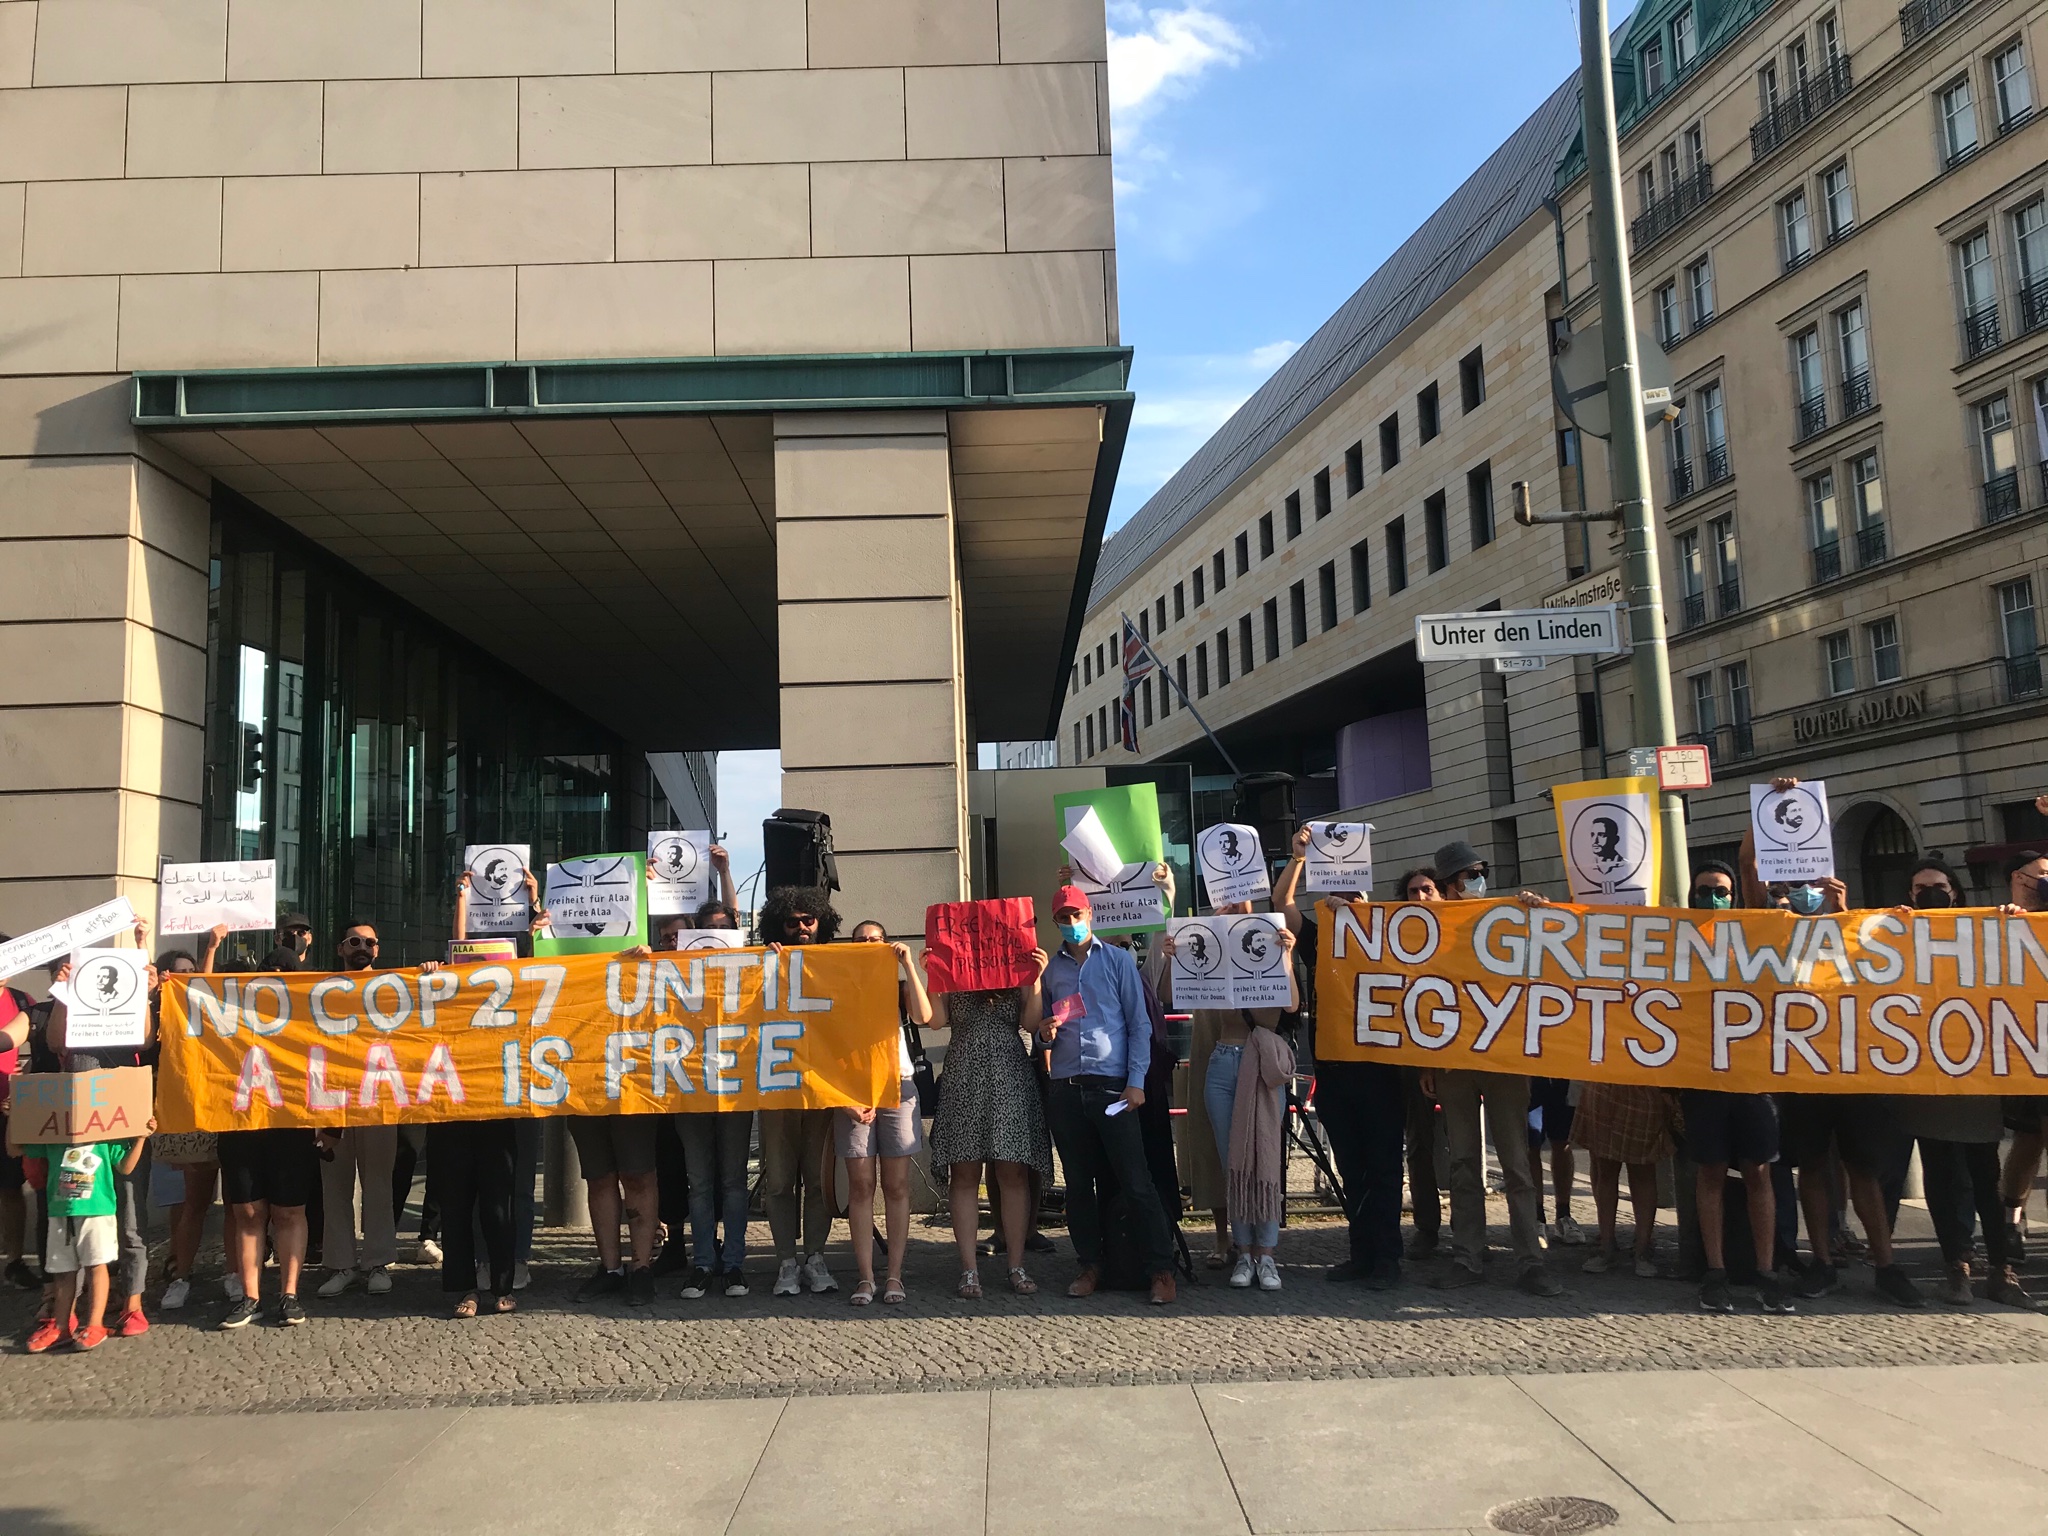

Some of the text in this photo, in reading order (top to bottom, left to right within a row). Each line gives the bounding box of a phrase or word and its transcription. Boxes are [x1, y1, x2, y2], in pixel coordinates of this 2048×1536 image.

[1431, 618, 1602, 645] Unter den Linden
[1793, 690, 1925, 740] HOTEL ADLON
[1630, 755, 1638, 764] S
[1661, 751, 1693, 760] H 150
[547, 893, 630, 905] Freiheit für Alaa
[1093, 898, 1158, 911] iheit für Alaa
[1213, 886, 1267, 903] Freiheit für Douma
[936, 915, 980, 938] FREE
[1332, 905, 1440, 964] NO
[0, 932, 53, 956] eenwashing
[453, 945, 475, 953] ALAA
[955, 936, 1023, 953] POLITICAL
[956, 953, 1029, 974] PRISONERS
[186, 949, 834, 1037] NO COP27 UNTIL
[1355, 972, 2048, 1078] EGYPT'S PRISON
[233, 1021, 806, 1111] ALAA IS FREE
[16, 1074, 114, 1107] FREE
[39, 1106, 129, 1136] ALAA
